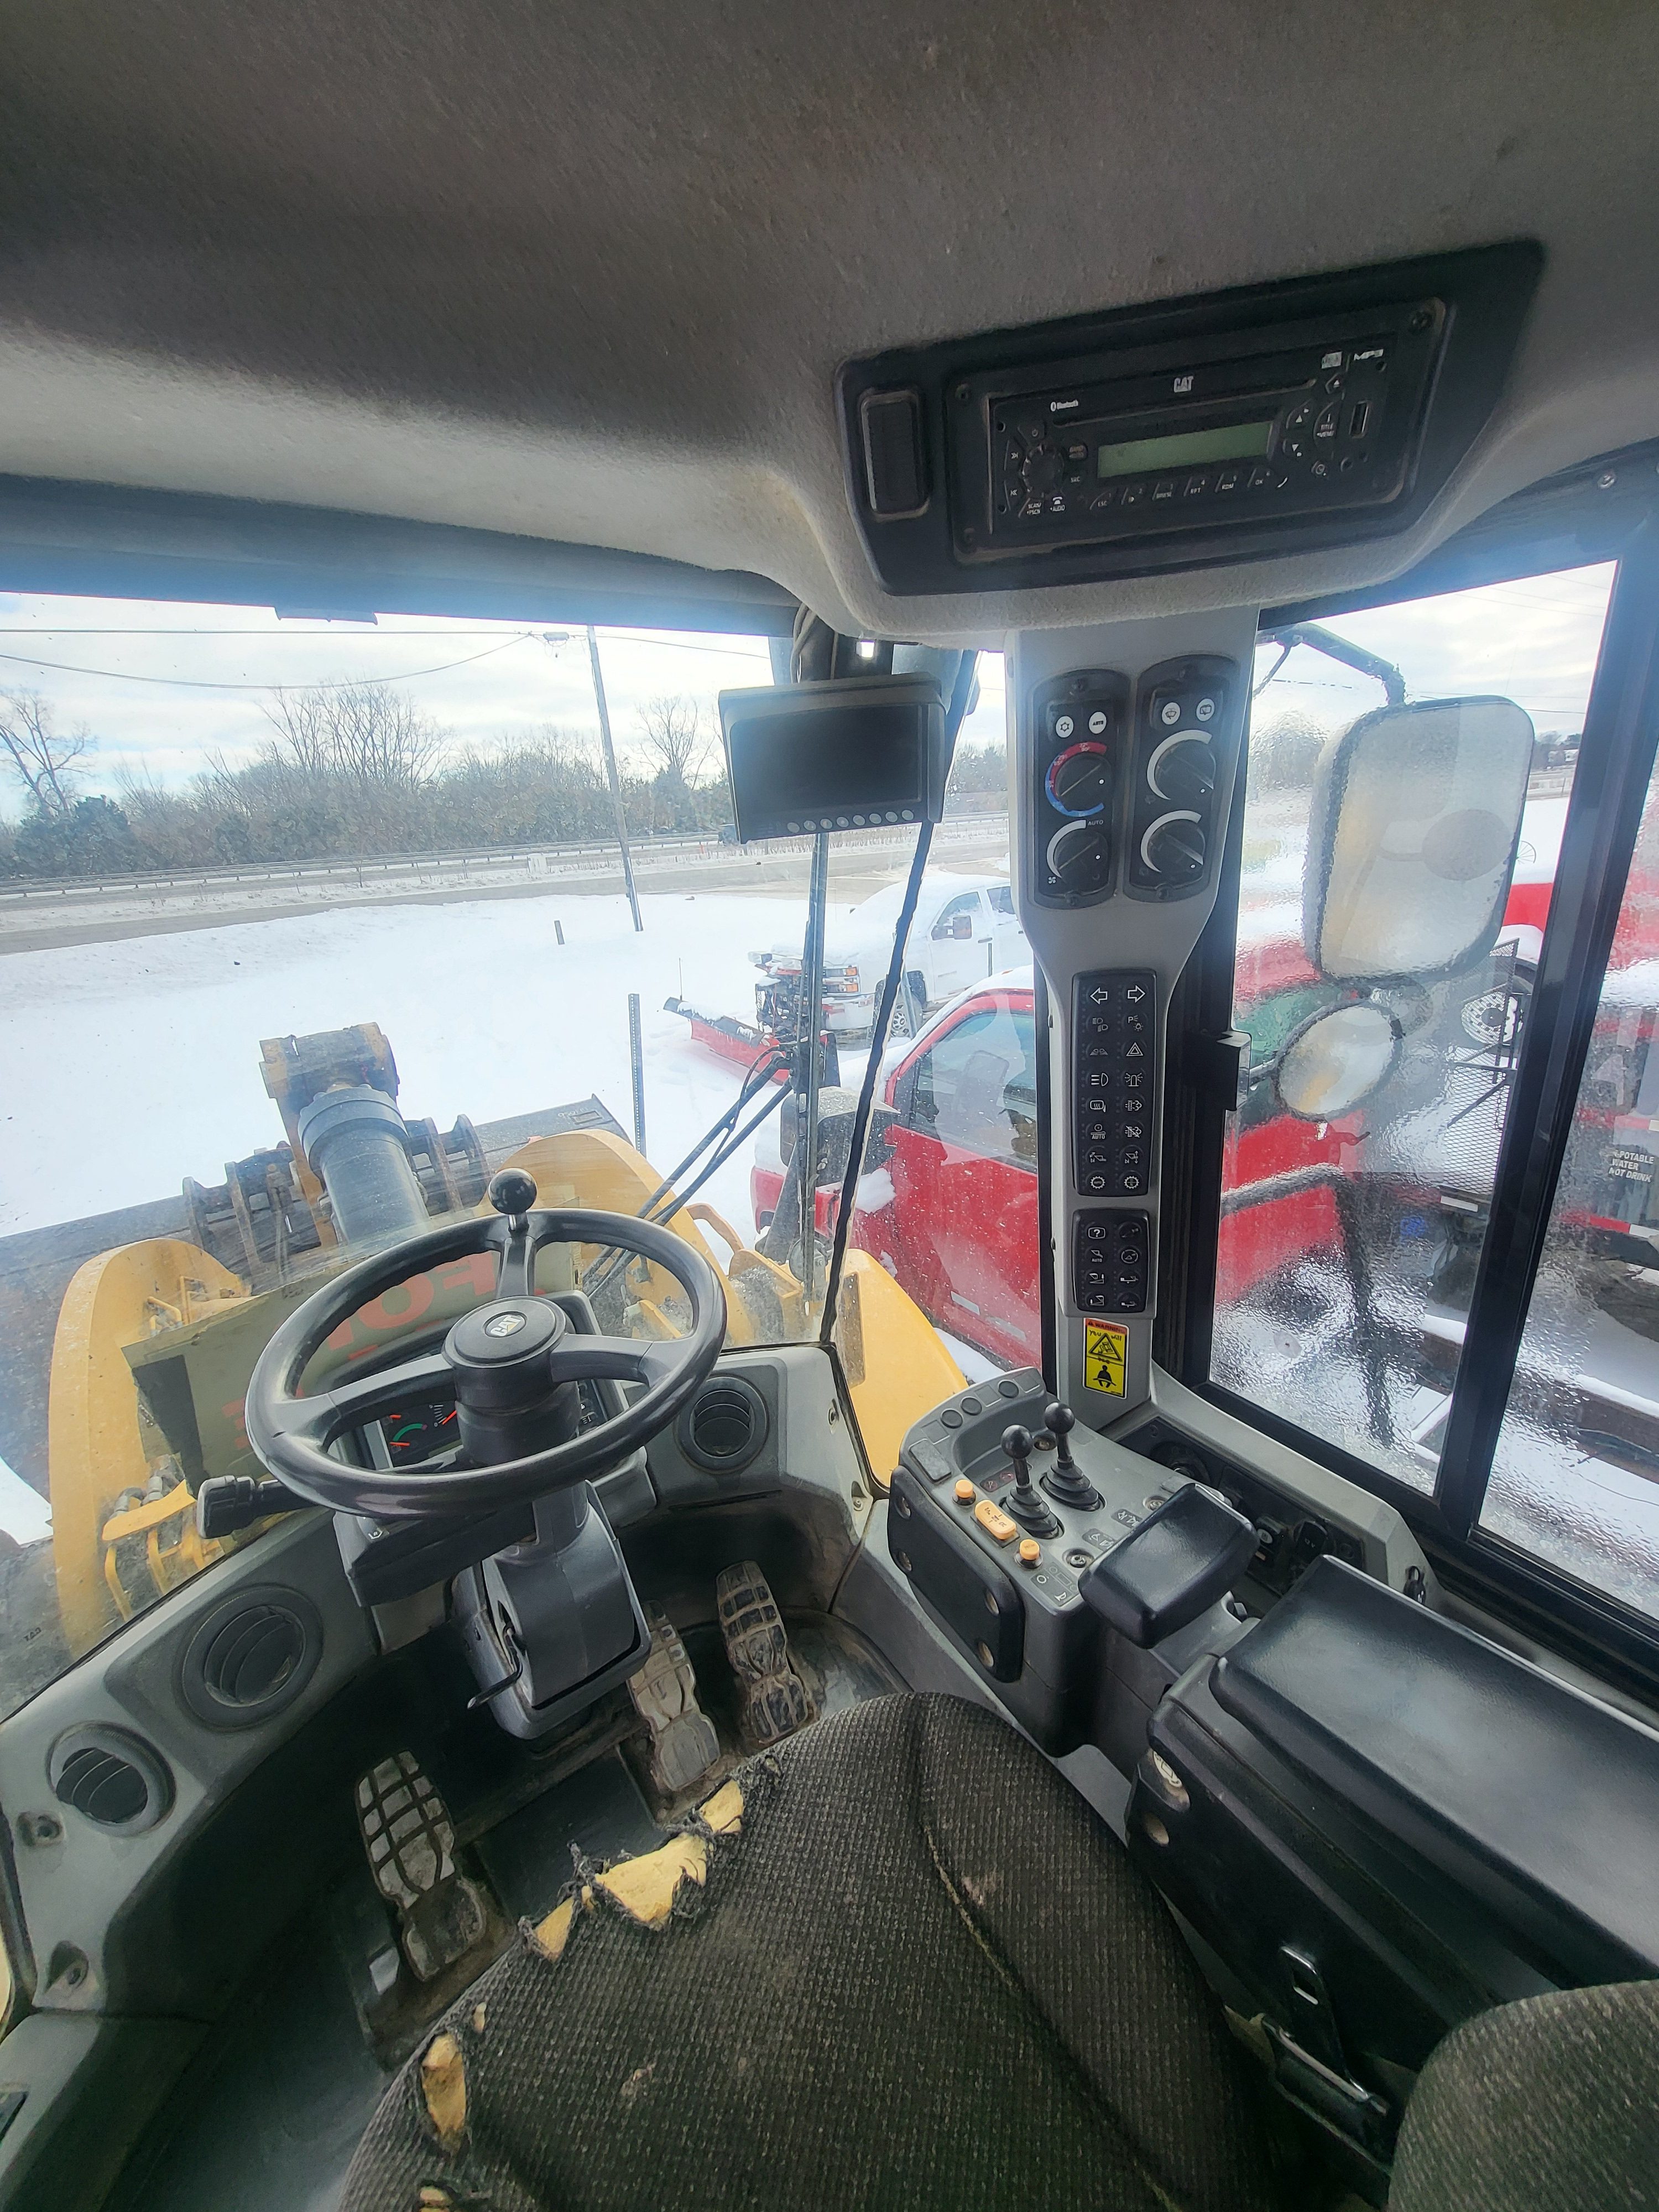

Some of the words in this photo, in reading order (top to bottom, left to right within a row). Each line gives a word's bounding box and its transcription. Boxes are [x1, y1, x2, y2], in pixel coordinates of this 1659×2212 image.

[1173, 376, 1193, 392] CAT
[1626, 1171, 1652, 1182] DRINK
[491, 1314, 521, 1336] CAT
